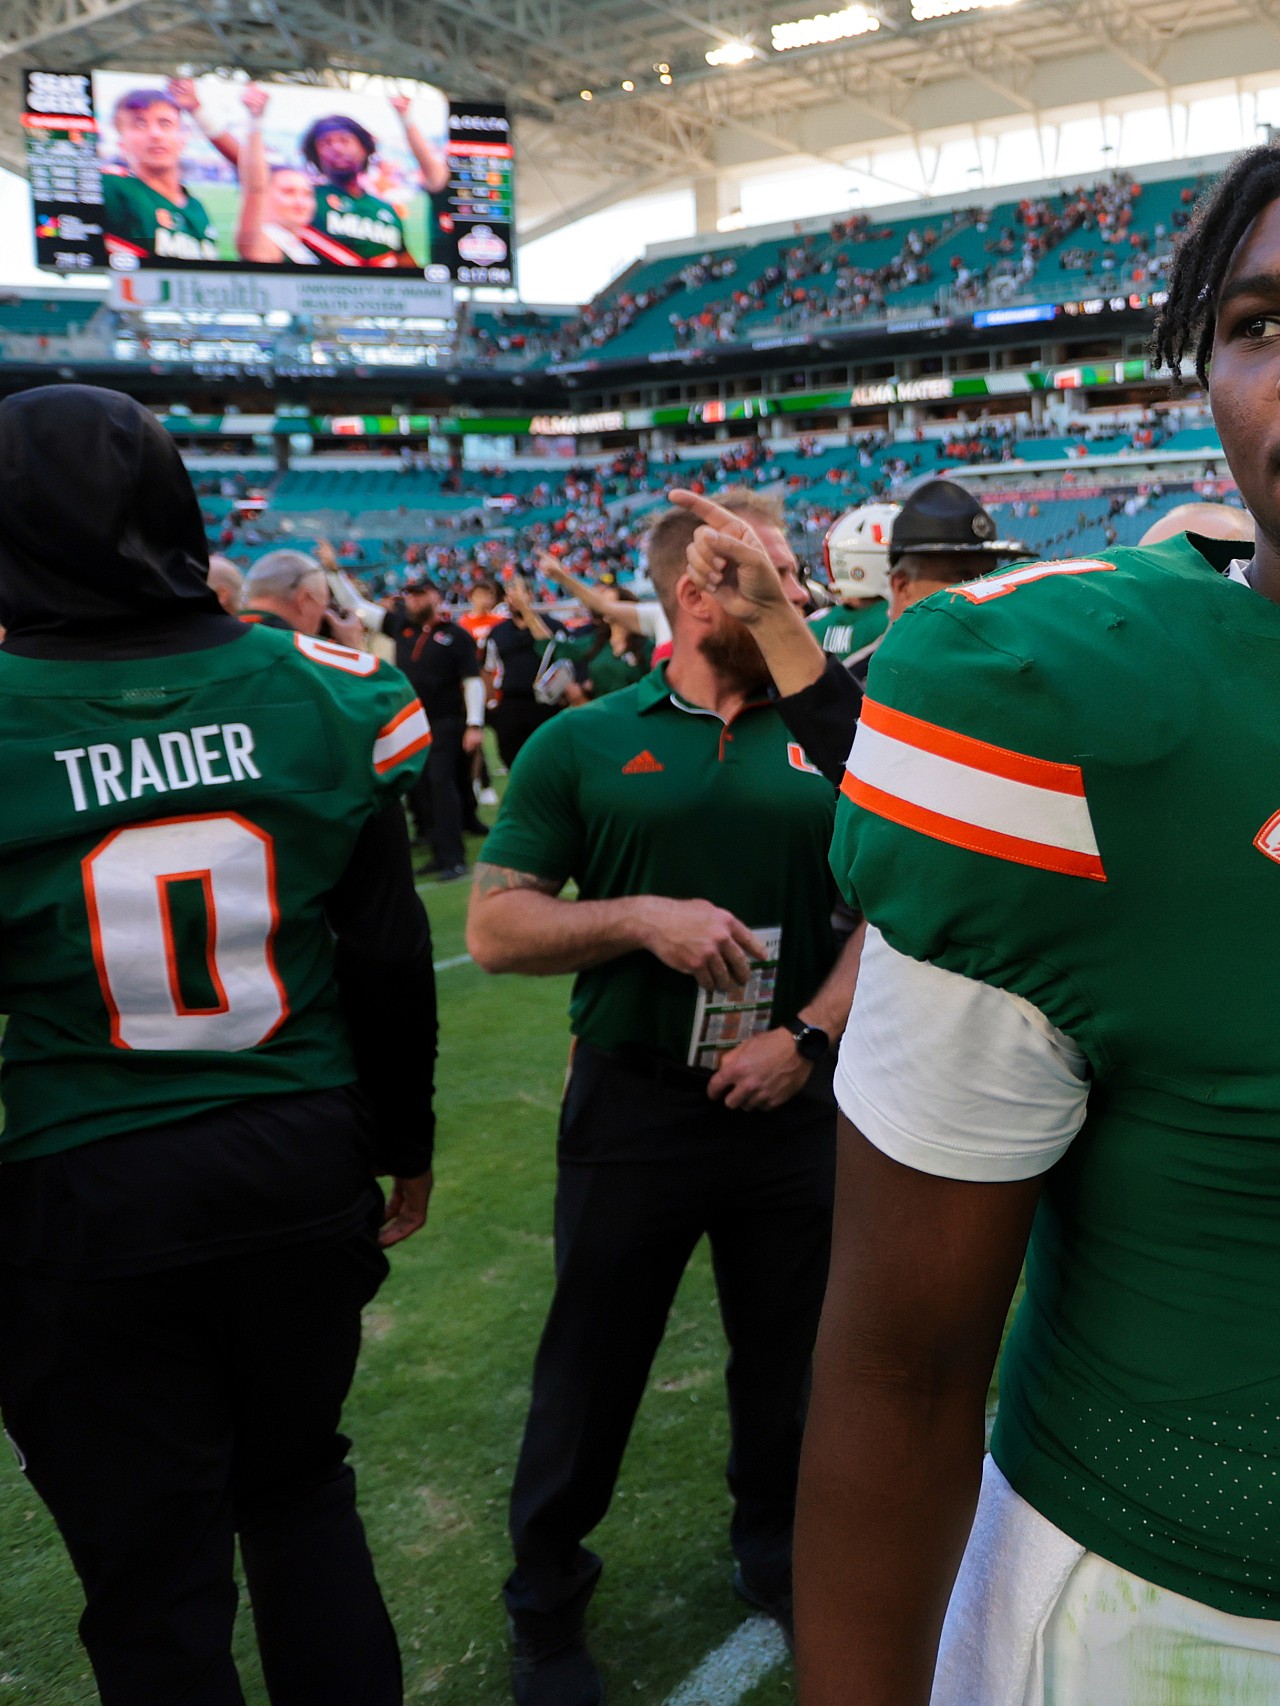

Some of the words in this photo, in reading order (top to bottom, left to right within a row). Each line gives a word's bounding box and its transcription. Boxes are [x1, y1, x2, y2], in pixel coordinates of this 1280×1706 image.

[850, 382, 897, 407] ALMA
[897, 378, 954, 402] MATER
[529, 414, 578, 435] ALMA
[578, 411, 624, 433] MATER
[822, 625, 854, 653] LUNA
[53, 722, 262, 812] TRADER
[80, 810, 291, 1053] 0
